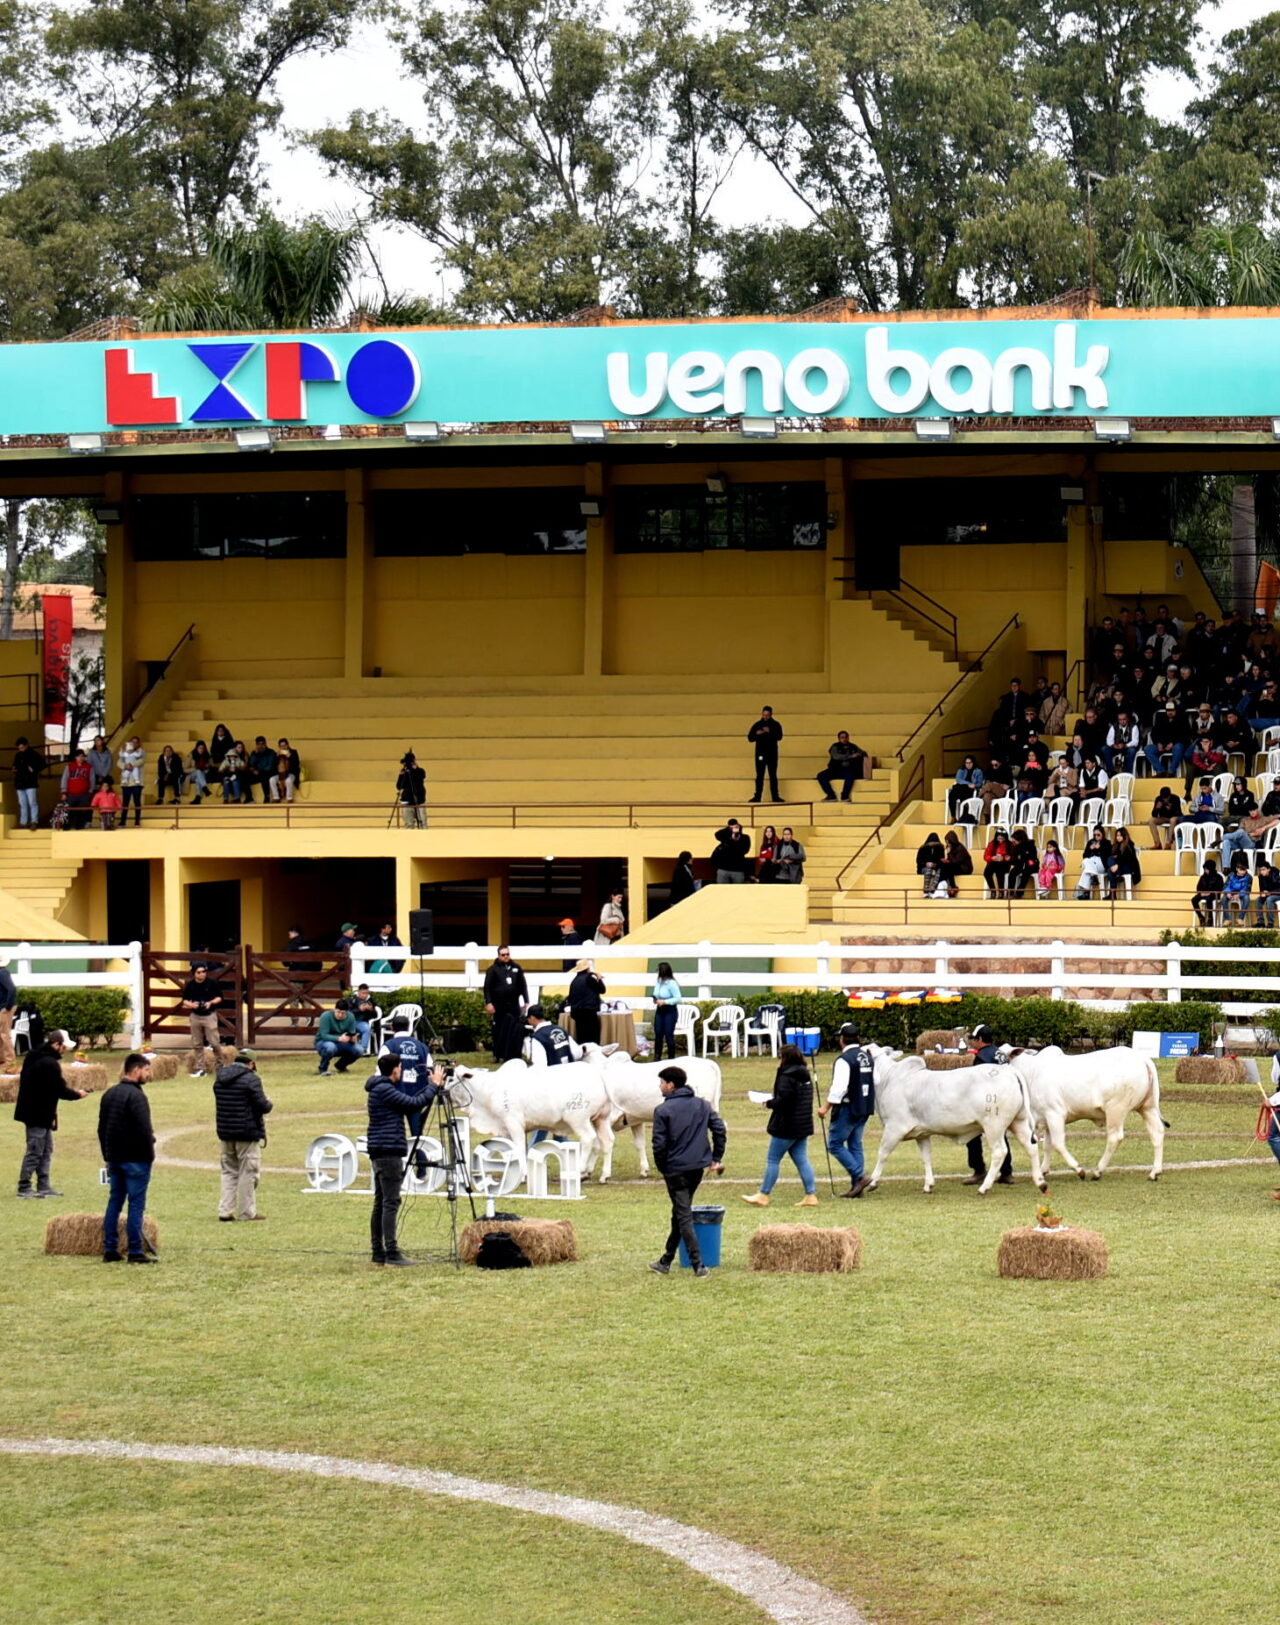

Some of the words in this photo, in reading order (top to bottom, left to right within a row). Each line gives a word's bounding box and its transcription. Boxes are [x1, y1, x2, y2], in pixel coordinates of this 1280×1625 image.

[105, 340, 421, 426] EXPO
[607, 348, 850, 415] ueno
[865, 323, 1110, 414] bank
